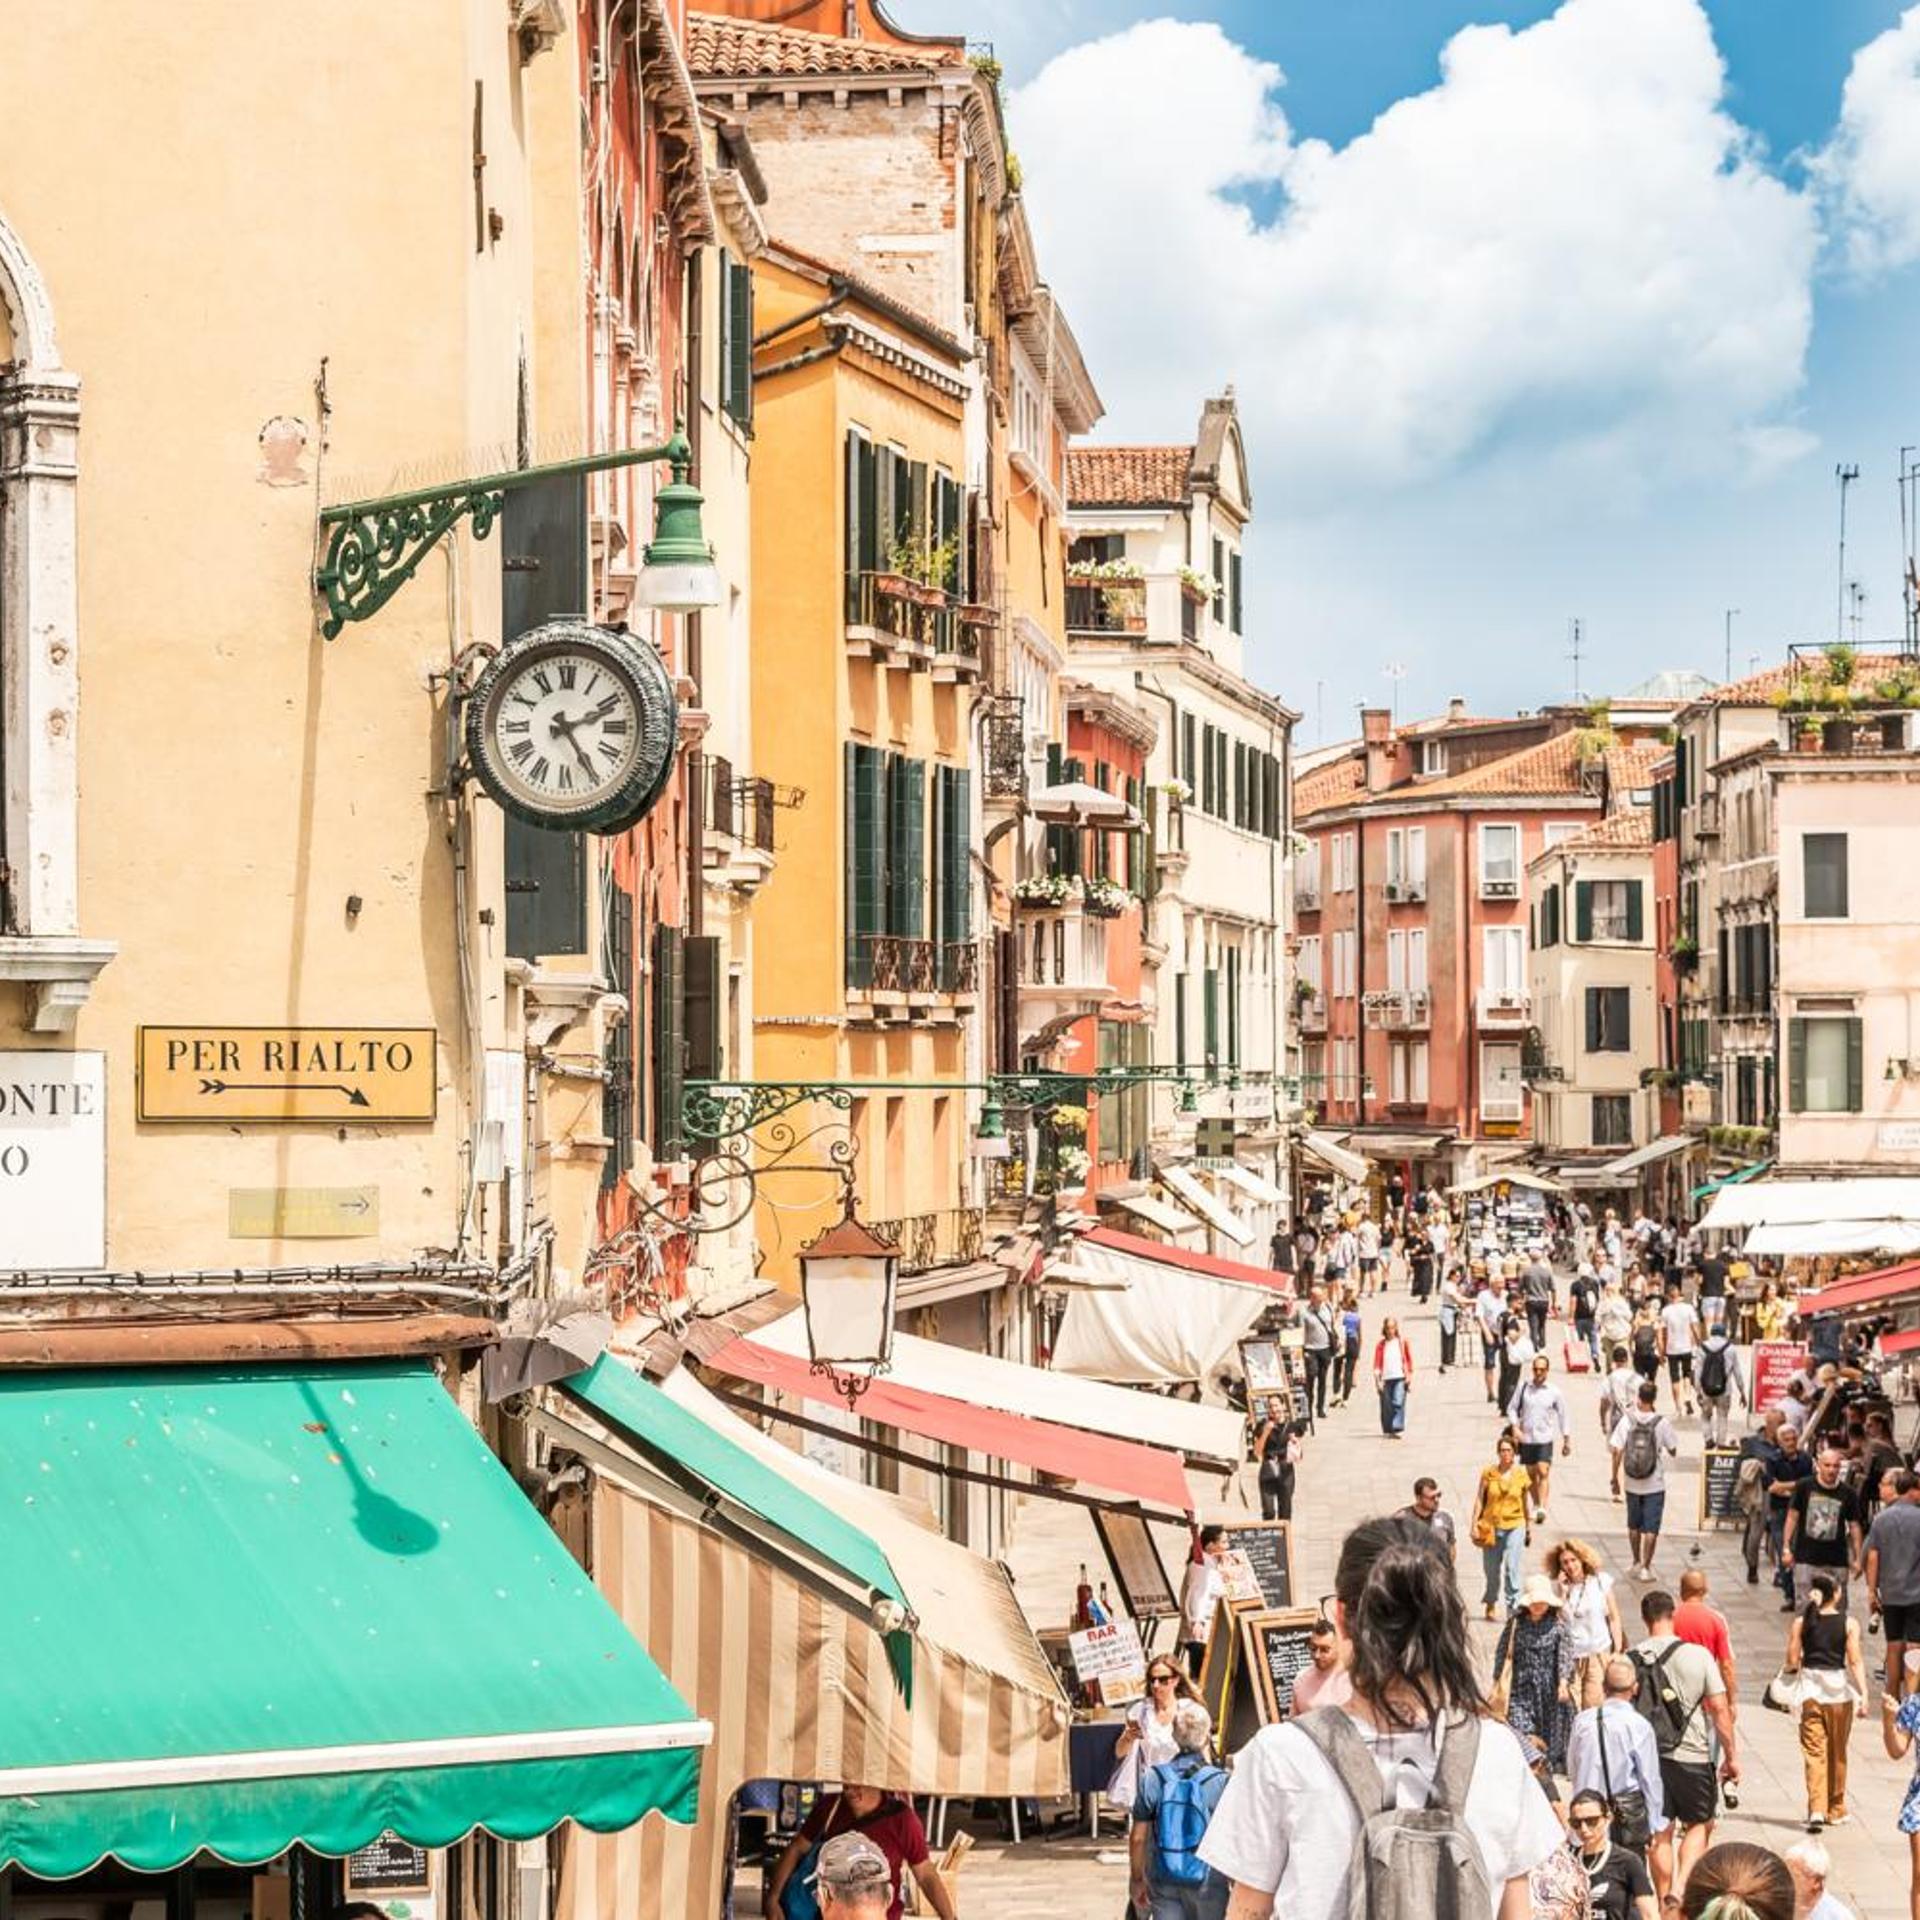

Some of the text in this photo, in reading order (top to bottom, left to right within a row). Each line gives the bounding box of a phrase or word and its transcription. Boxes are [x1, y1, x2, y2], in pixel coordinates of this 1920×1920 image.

[584, 673, 600, 696] I
[166, 1040, 413, 1072] PER RIALTO
[0, 1084, 93, 1115] NTE
[1087, 1625, 1117, 1642] BAR
